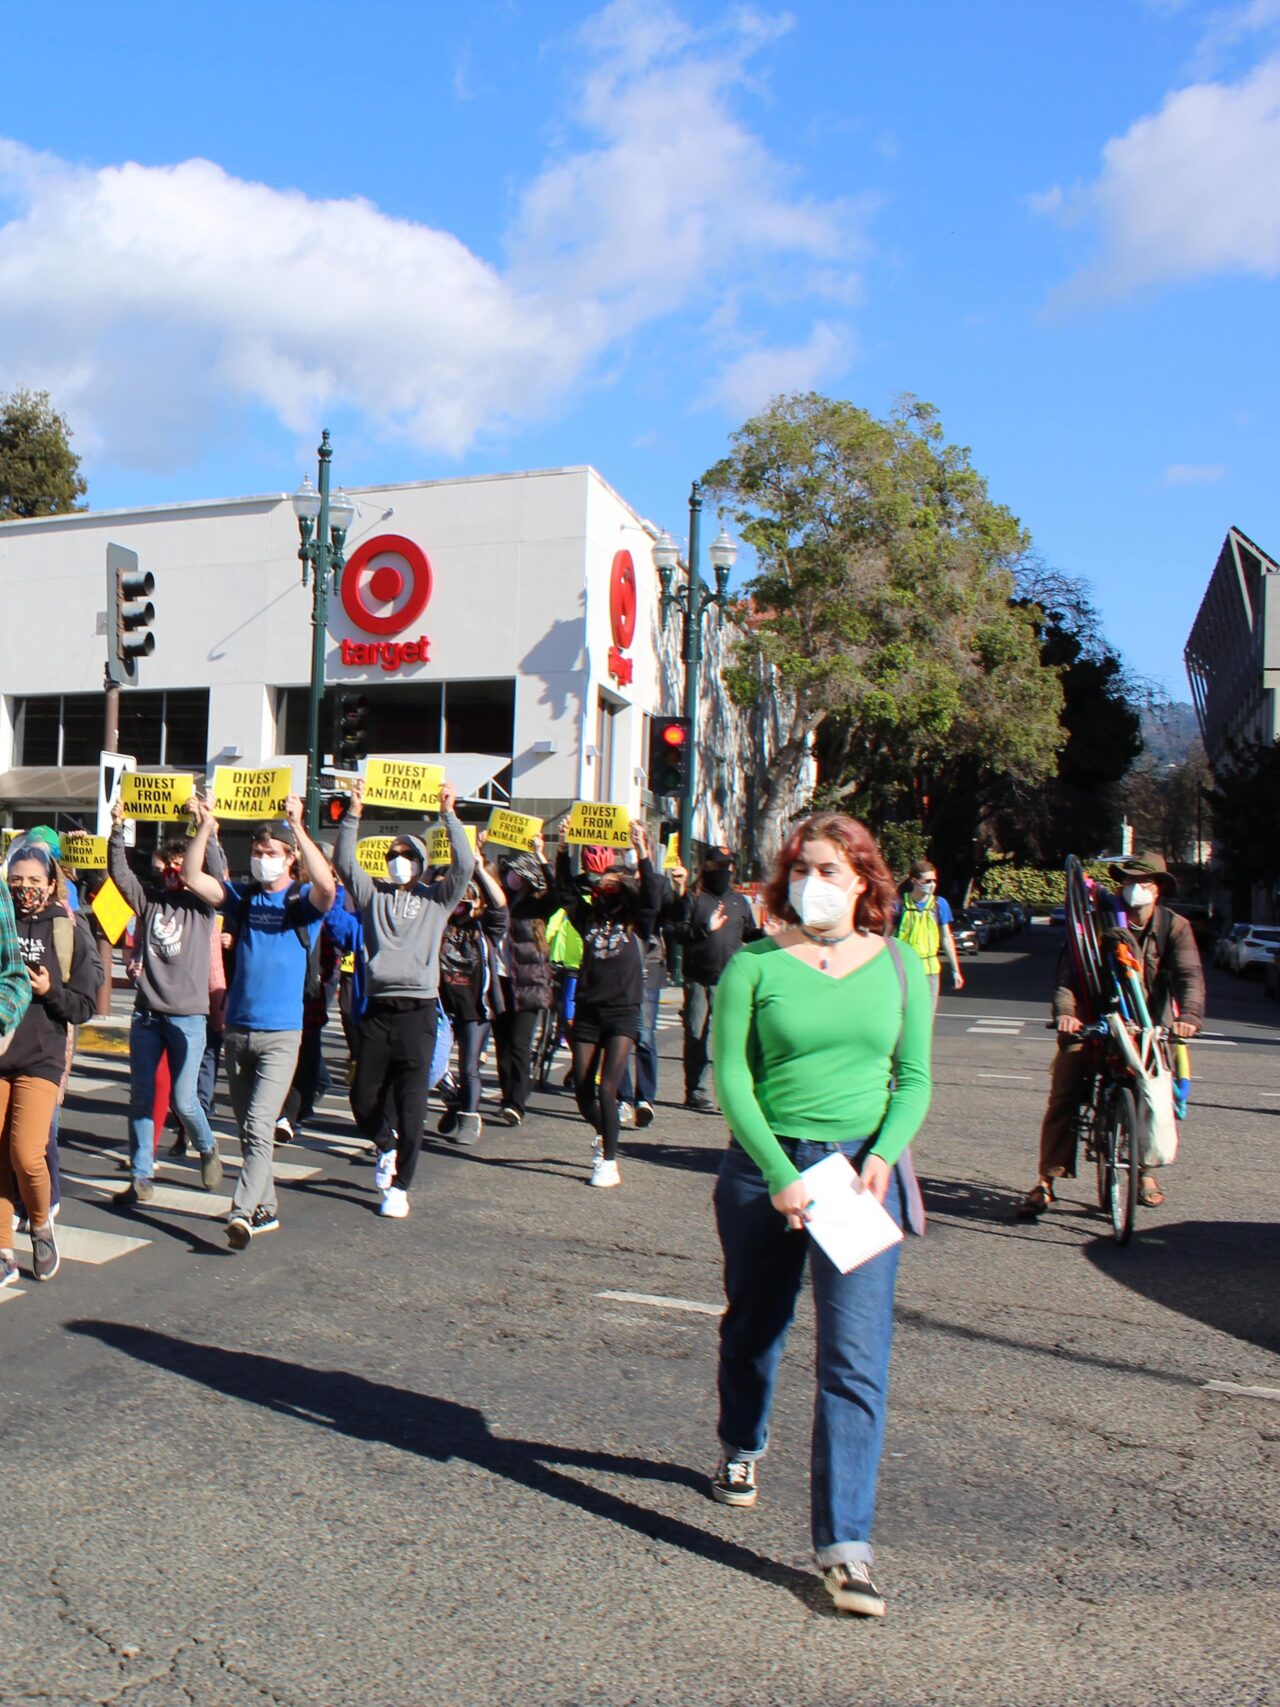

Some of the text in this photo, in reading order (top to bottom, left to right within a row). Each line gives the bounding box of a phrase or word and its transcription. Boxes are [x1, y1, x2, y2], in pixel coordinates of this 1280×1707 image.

[339, 635, 431, 671] target
[383, 763, 428, 778] DIVEST
[134, 776, 176, 790] DIVEST
[233, 771, 277, 785] DIVEST
[385, 776, 421, 790] FROM
[138, 789, 171, 802] FROM
[235, 786, 270, 798] FROM
[366, 787, 438, 805] ANIMAL AG
[123, 801, 166, 815] ANIMAL
[215, 798, 264, 812] ANIMAL
[581, 805, 618, 817] DIVEST
[499, 812, 529, 826] DIVEST
[583, 817, 613, 829] FROM
[499, 822, 524, 835] FROM
[568, 828, 628, 842] ANIMAL AG
[433, 839, 449, 848] FRO
[488, 829, 518, 844] ANIMAL
[68, 846, 93, 856] FROM
[94, 856, 106, 865] AG
[360, 861, 385, 871] IMAL
